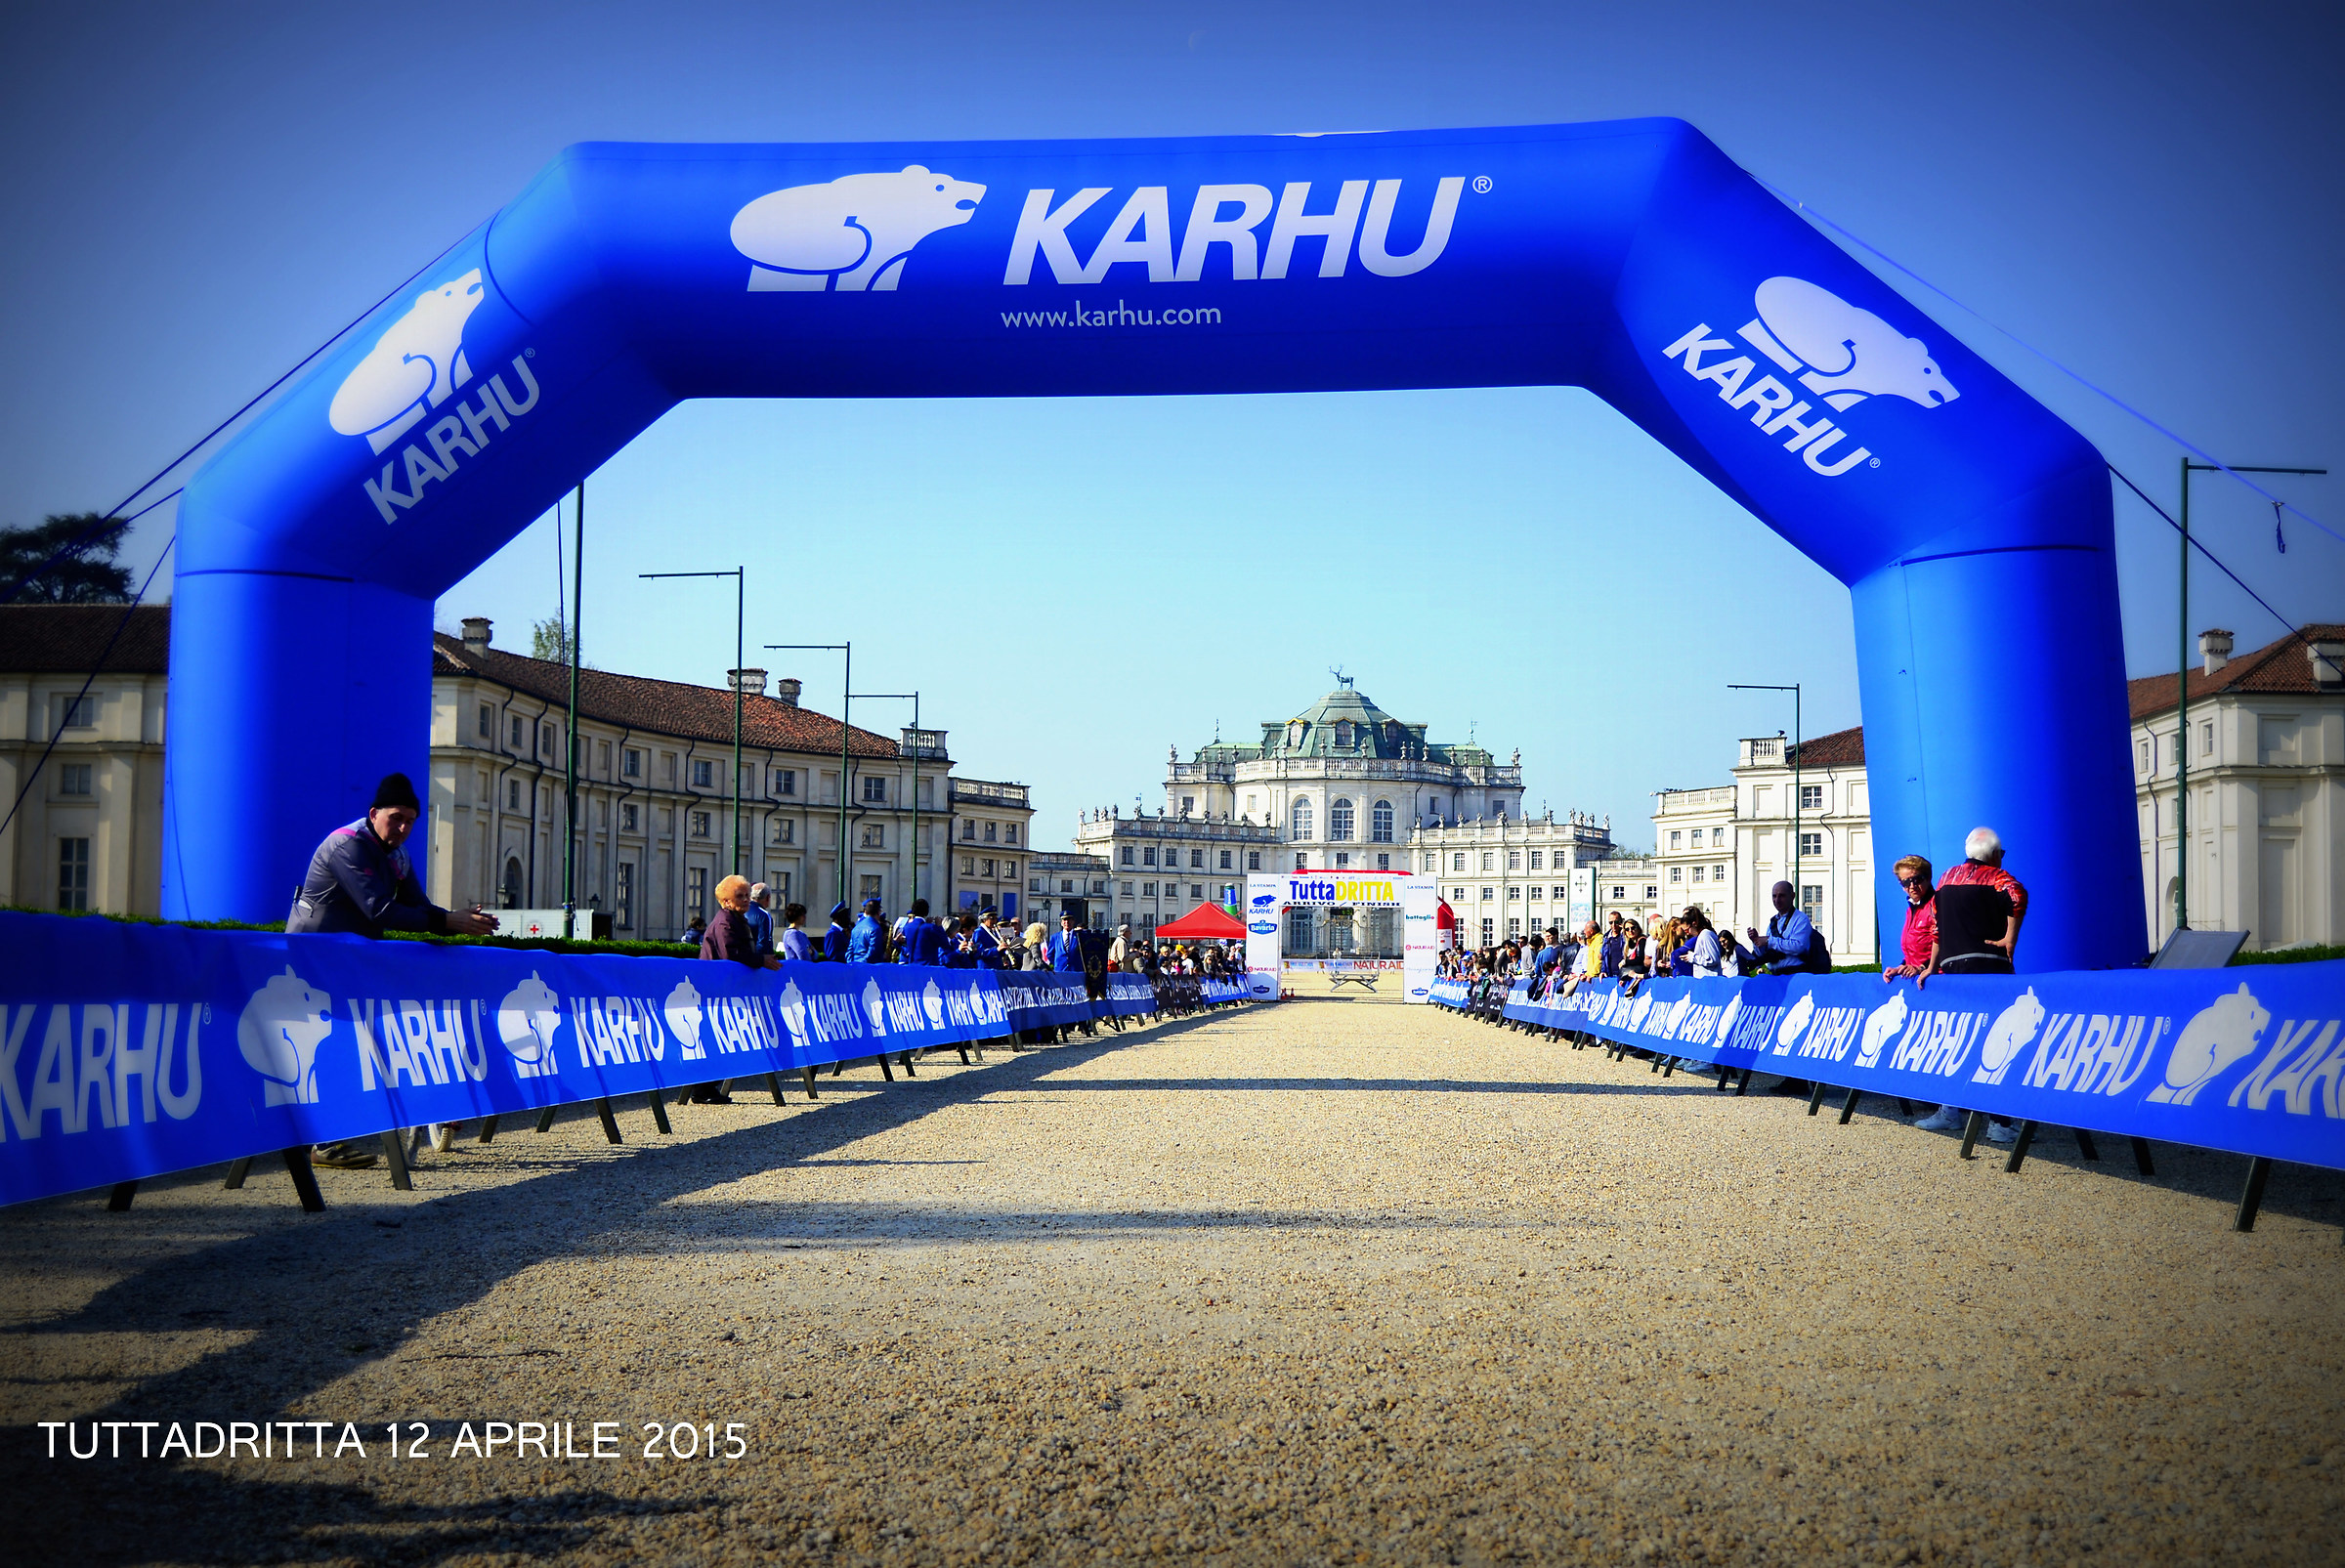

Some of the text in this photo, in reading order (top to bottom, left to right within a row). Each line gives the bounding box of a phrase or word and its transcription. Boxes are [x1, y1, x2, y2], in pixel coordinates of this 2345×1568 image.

[1003, 176, 1466, 285] KARHU
[1001, 299, 1221, 328] www.karhu.com
[1662, 322, 1871, 476] KARHU
[362, 354, 539, 526] KARHU
[348, 998, 488, 1092] KARHU
[570, 996, 664, 1068] KARHU
[707, 996, 779, 1054] KARHU
[807, 994, 863, 1042] KARHU
[884, 991, 924, 1033] KARHU
[1677, 1002, 1721, 1045] KARHU
[1729, 1004, 1781, 1052] KARHU
[1798, 1007, 1862, 1062] KARHU
[1889, 1010, 1984, 1078] KARHU
[0, 1002, 202, 1143] KARHU
[2022, 1014, 2163, 1096] KARHU
[2227, 1019, 2345, 1120] KAR
